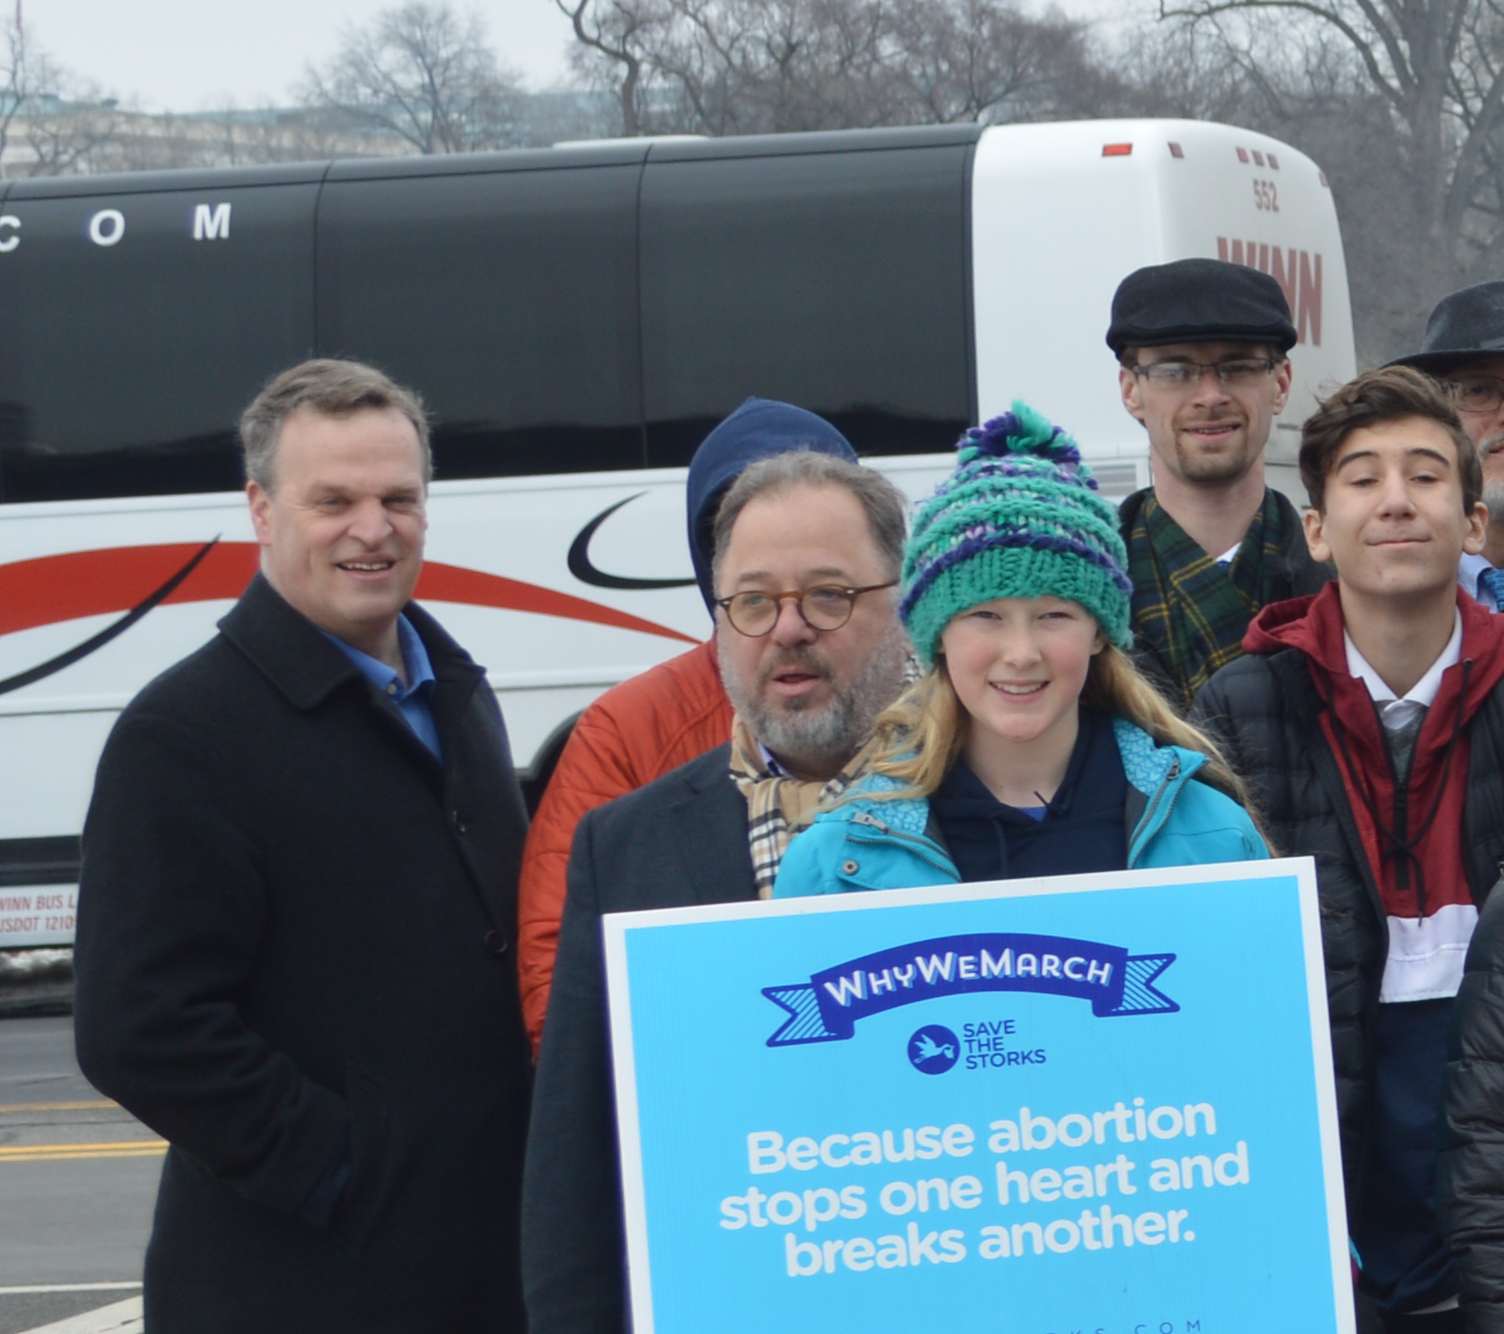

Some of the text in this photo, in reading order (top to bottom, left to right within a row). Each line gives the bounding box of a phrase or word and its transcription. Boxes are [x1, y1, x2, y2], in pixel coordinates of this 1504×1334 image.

[1253, 179, 1280, 213] 552
[36, 895, 63, 910] BUS
[963, 1019, 1016, 1038] SAVE
[964, 1036, 1005, 1053] THE
[965, 1048, 1047, 1070] STORKS
[747, 1097, 1217, 1174] Because abortion
[719, 1141, 1250, 1231] stops one heart and
[784, 1205, 1196, 1277] breaks another.
